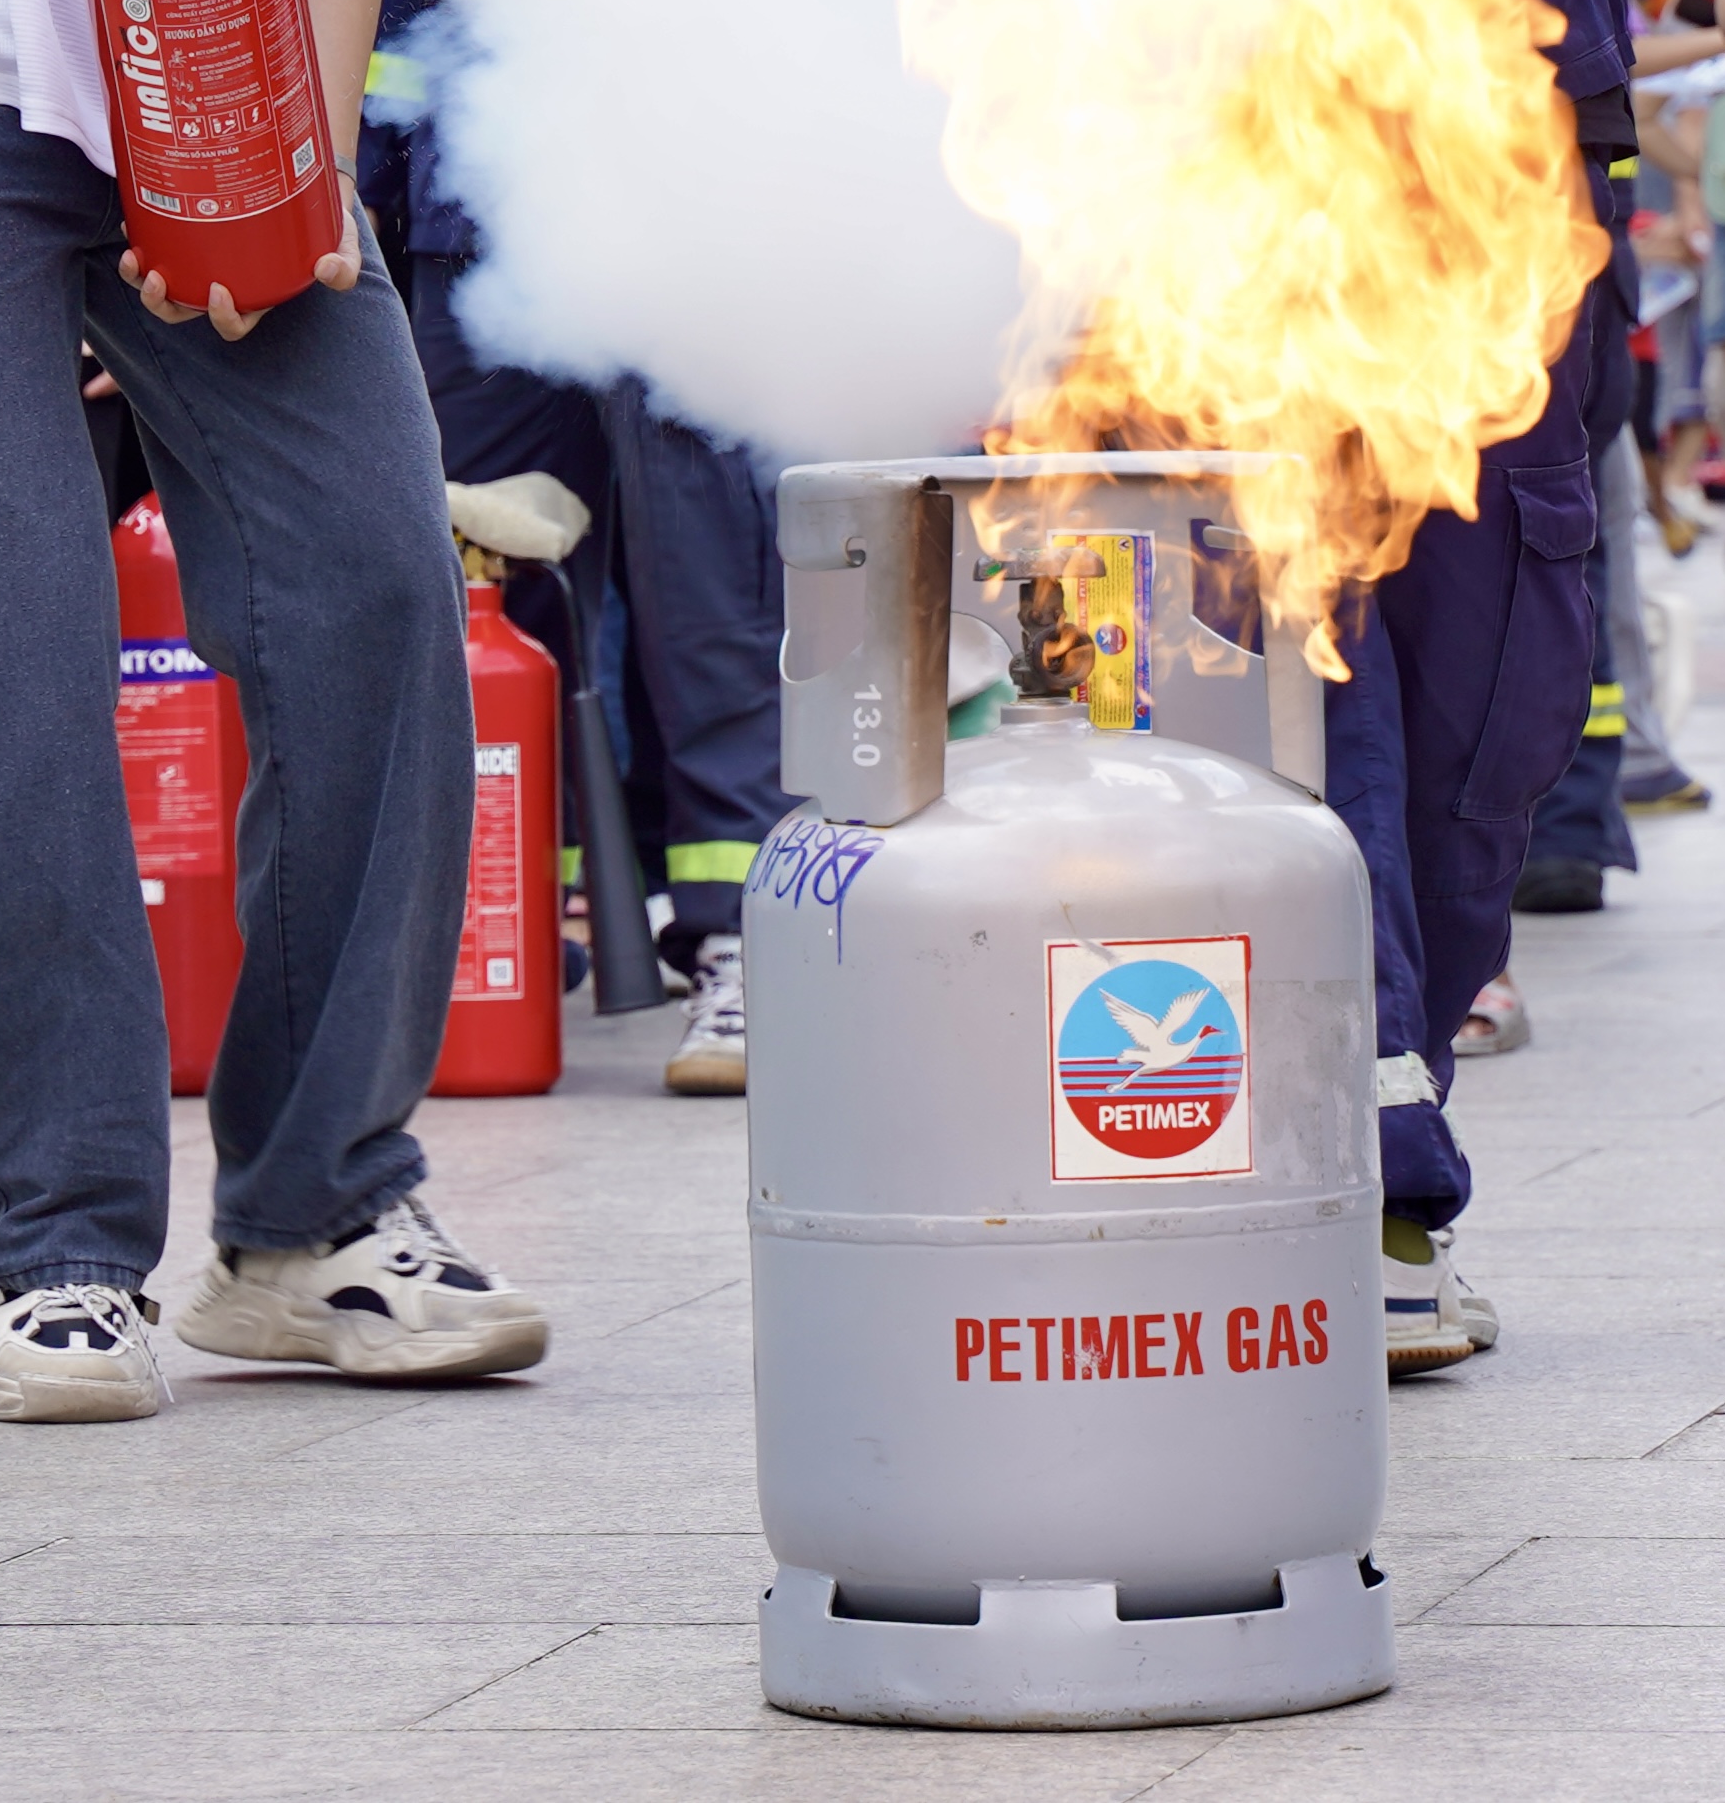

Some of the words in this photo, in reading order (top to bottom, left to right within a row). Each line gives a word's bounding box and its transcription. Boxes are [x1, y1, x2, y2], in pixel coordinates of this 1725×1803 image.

[164, 28, 195, 40] HƯỚNG
[197, 23, 215, 37] DẪN
[228, 13, 251, 29] DỤNG
[852, 683, 882, 767] 13.0
[1098, 1100, 1212, 1132] PETIMEX
[955, 1312, 1204, 1382] PETIMEX
[1227, 1298, 1329, 1374] GAS
